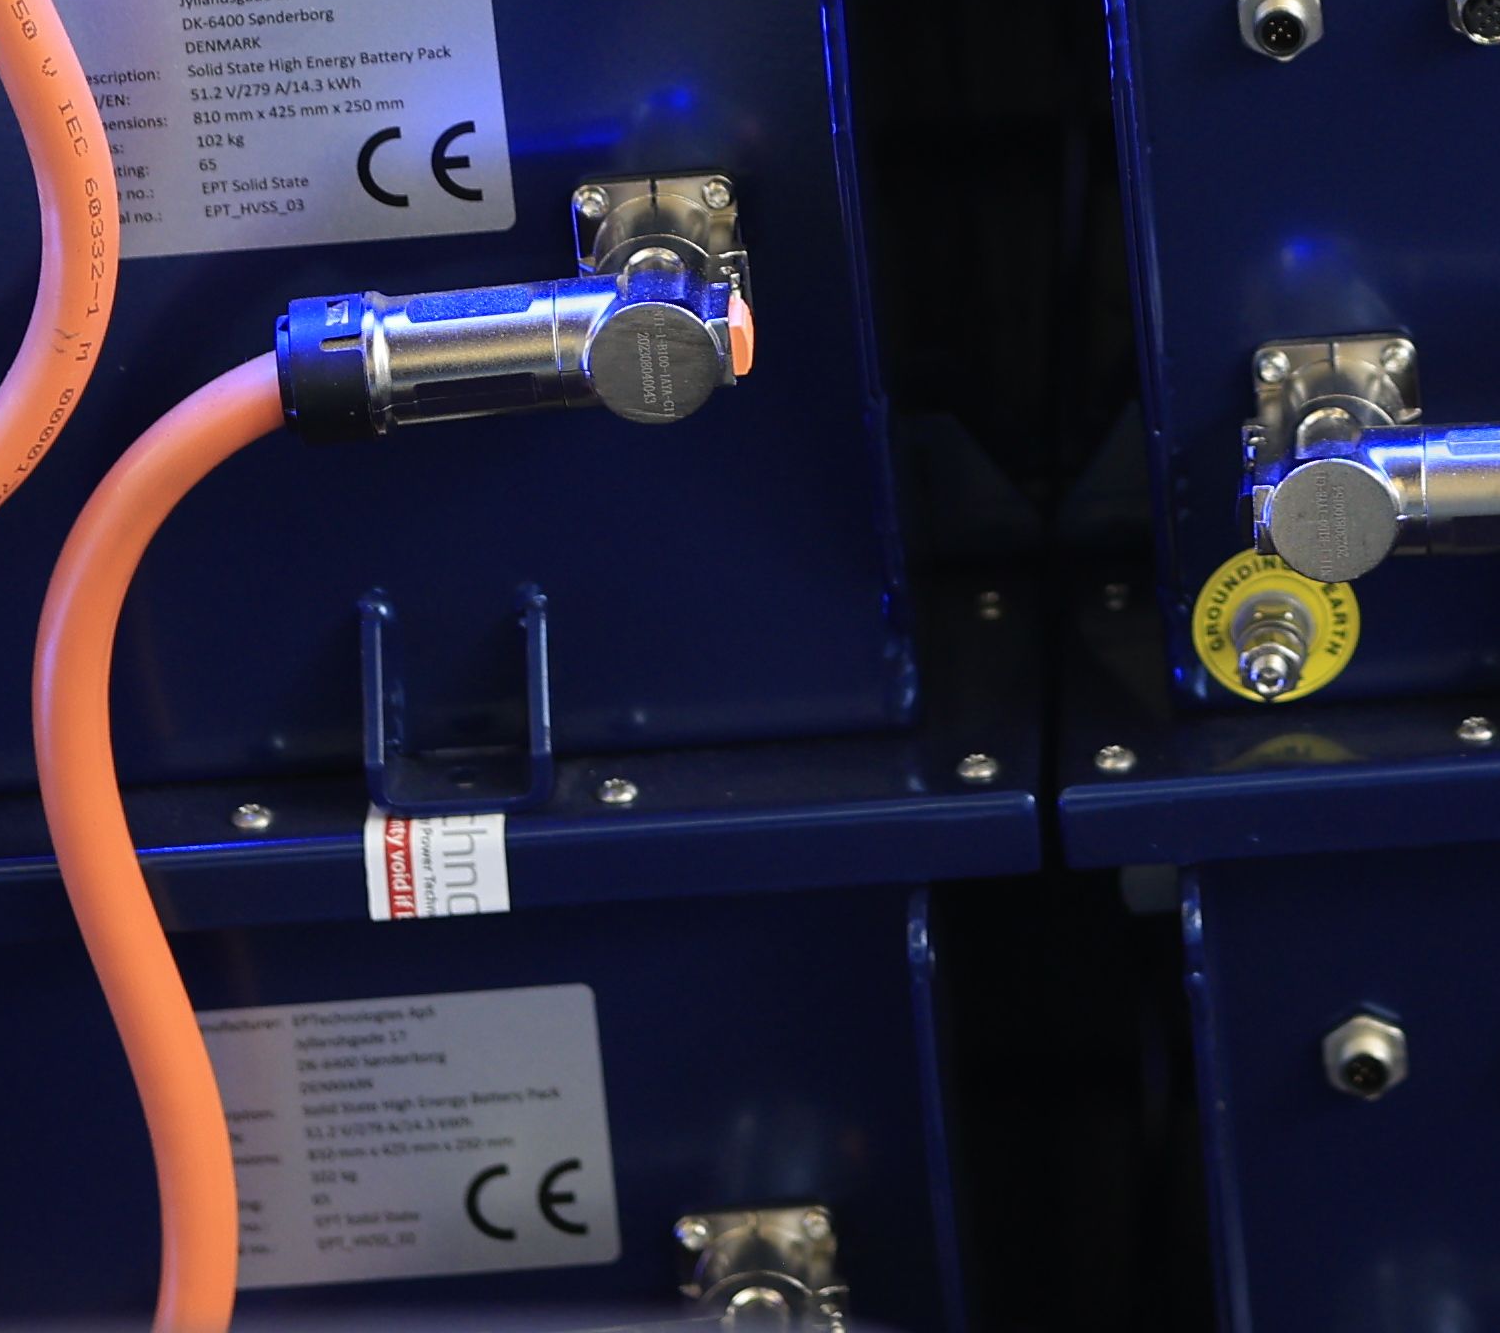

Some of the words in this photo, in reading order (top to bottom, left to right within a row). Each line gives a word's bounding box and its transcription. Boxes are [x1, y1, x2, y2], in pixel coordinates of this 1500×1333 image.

[182, 13, 245, 31] DK-6400
[247, 9, 334, 26] Sønderborg
[185, 36, 261, 54] DENMARK
[187, 62, 223, 78] Solid
[227, 61, 265, 75] State
[268, 57, 302, 74] High
[306, 56, 356, 69] Energy
[360, 51, 414, 65] Battery
[417, 45, 452, 60] Pack
[191, 86, 223, 101] 51.2
[327, 76, 361, 91] kWh
[40, 56, 58, 78] V
[58, 98, 89, 158] IEC
[125, 188, 155, 202] no.:
[201, 180, 228, 195] EPT
[232, 177, 268, 192] Solid
[271, 176, 309, 189] State
[133, 212, 163, 224] no.:
